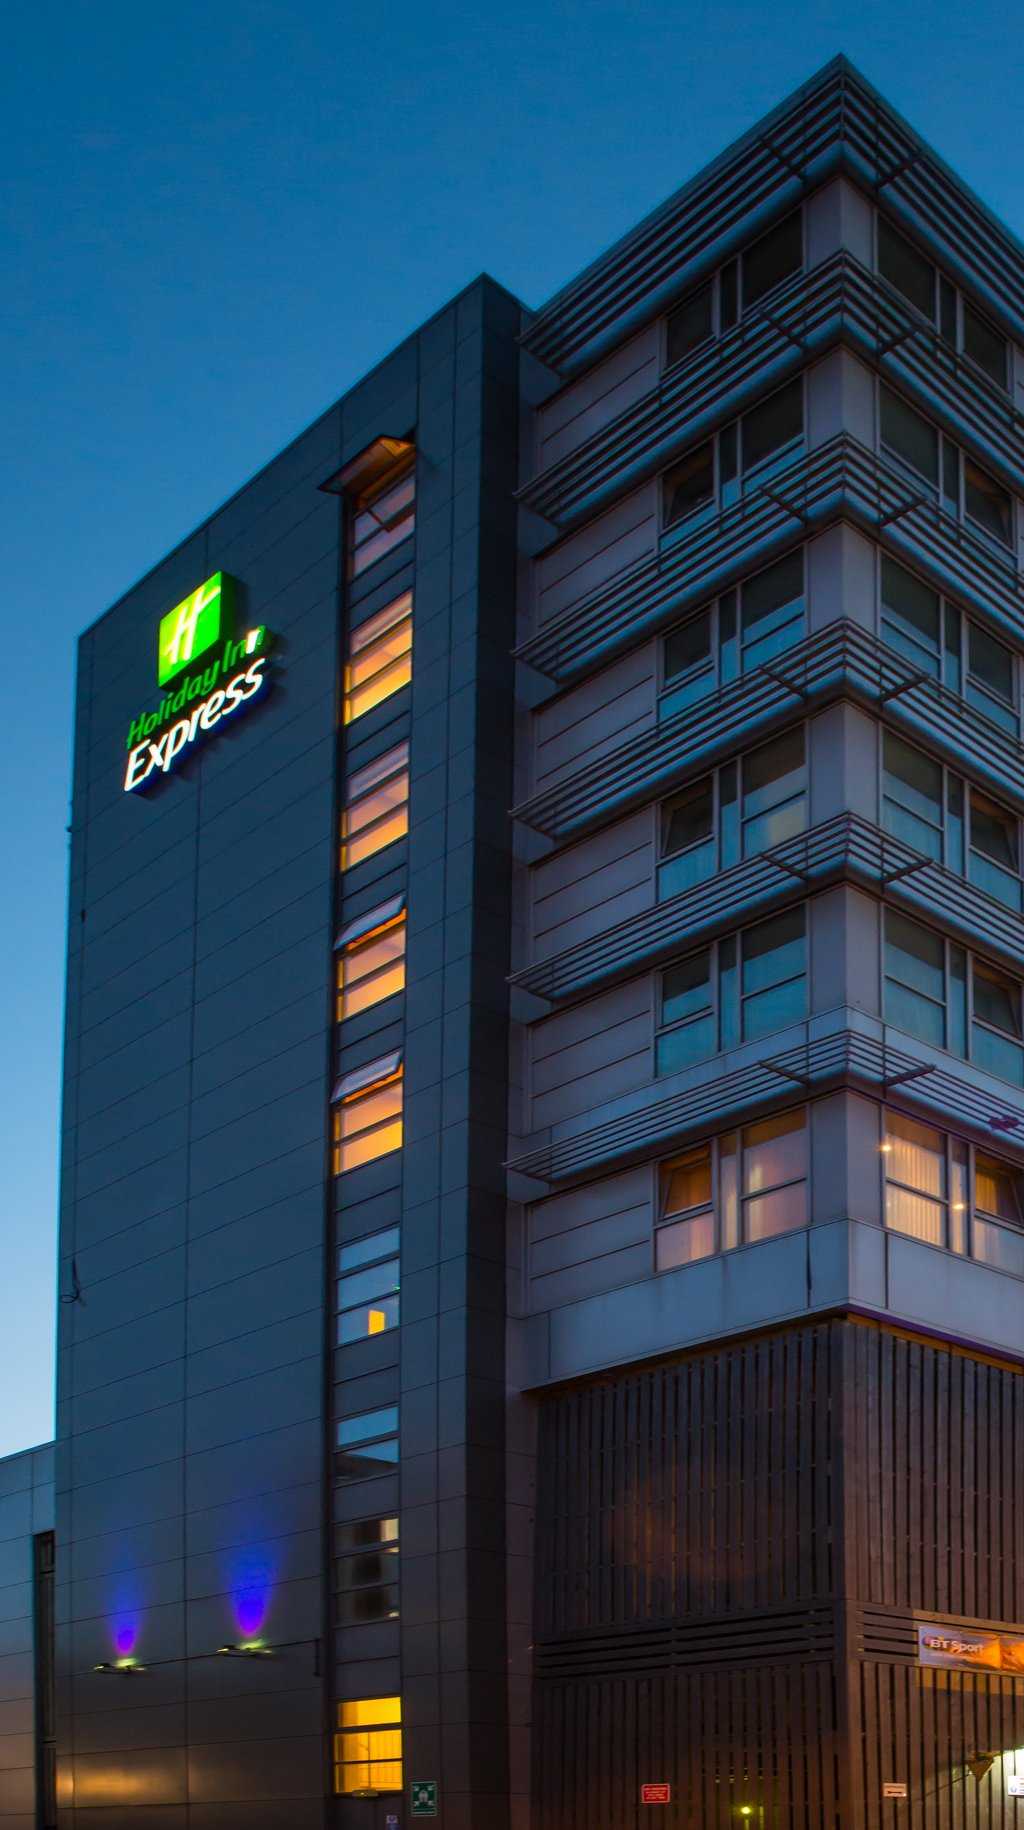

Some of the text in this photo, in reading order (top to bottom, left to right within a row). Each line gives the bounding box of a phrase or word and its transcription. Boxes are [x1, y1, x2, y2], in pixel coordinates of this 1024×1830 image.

[124, 656, 265, 791] Express
[126, 624, 266, 750] Holiday Inn
[930, 1639, 984, 1652] BT Sport
